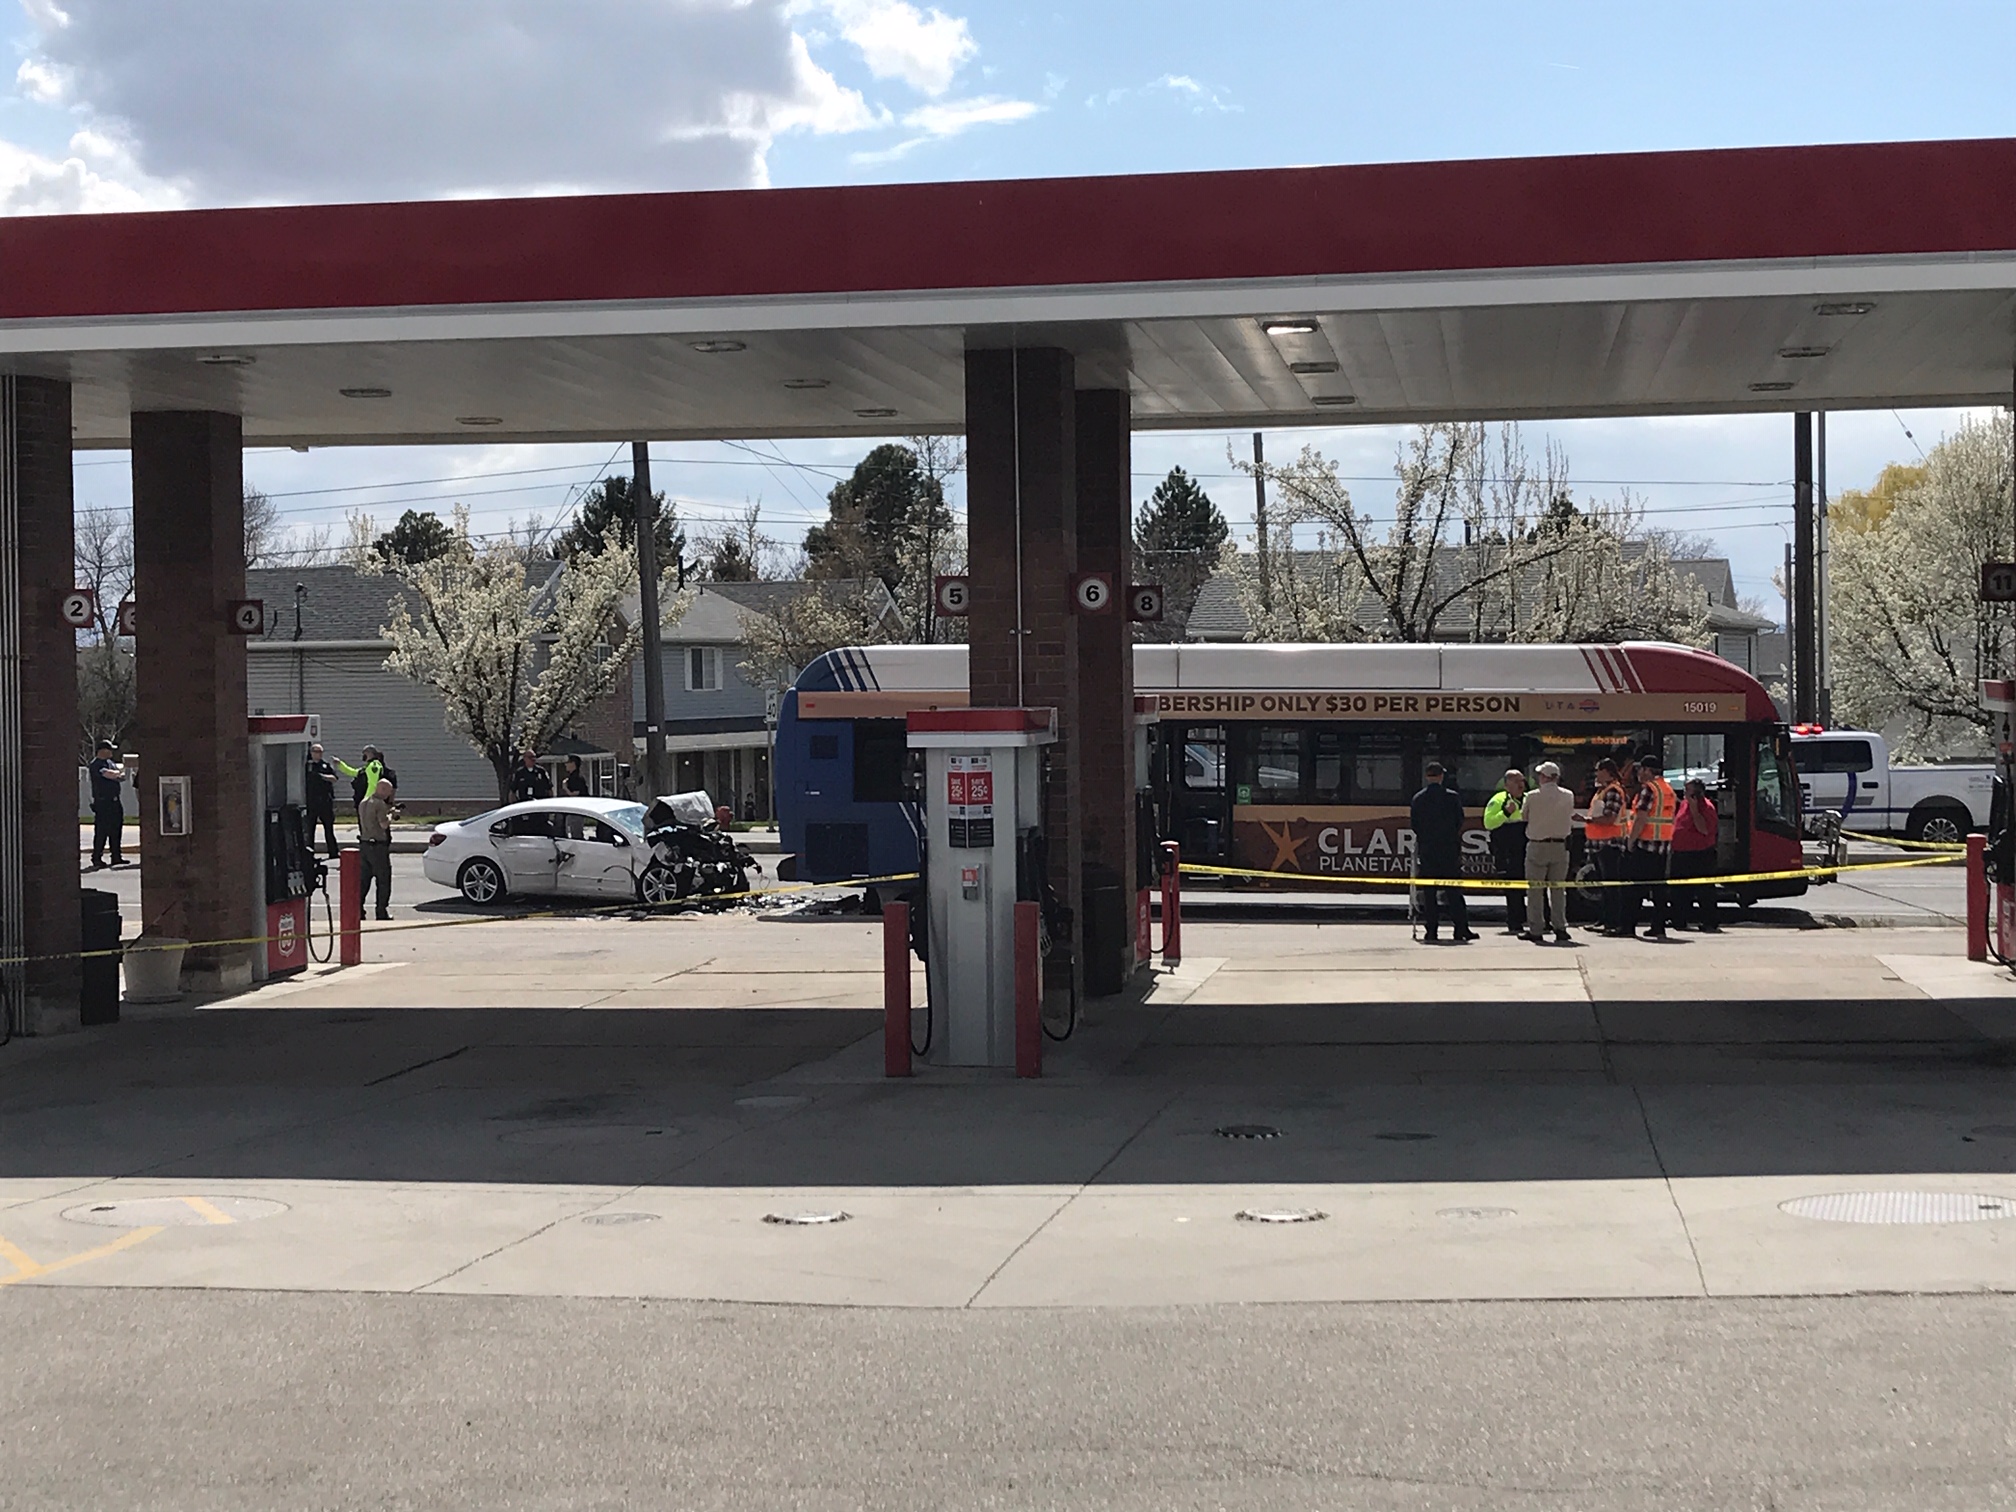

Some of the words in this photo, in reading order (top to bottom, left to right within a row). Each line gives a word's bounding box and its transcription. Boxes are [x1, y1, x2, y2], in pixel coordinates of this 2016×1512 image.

[1993, 574, 2012, 590] 11
[949, 588, 963, 605] 5
[1085, 585, 1100, 602] 6
[70, 600, 84, 617] 2
[1140, 595, 1154, 611] 8
[242, 610, 255, 625] 4
[1158, 695, 1256, 712] BERSHIP
[1260, 695, 1321, 712] ONLY
[1325, 694, 1367, 714] $30
[1373, 696, 1419, 712] PER
[1425, 696, 1521, 712] PERSON
[1684, 702, 1717, 713] 15019
[1541, 735, 1586, 745] Welcome
[1802, 793, 1812, 808] E
[1318, 827, 1418, 855] CLAR
[1319, 856, 1415, 872] PLANETAR
